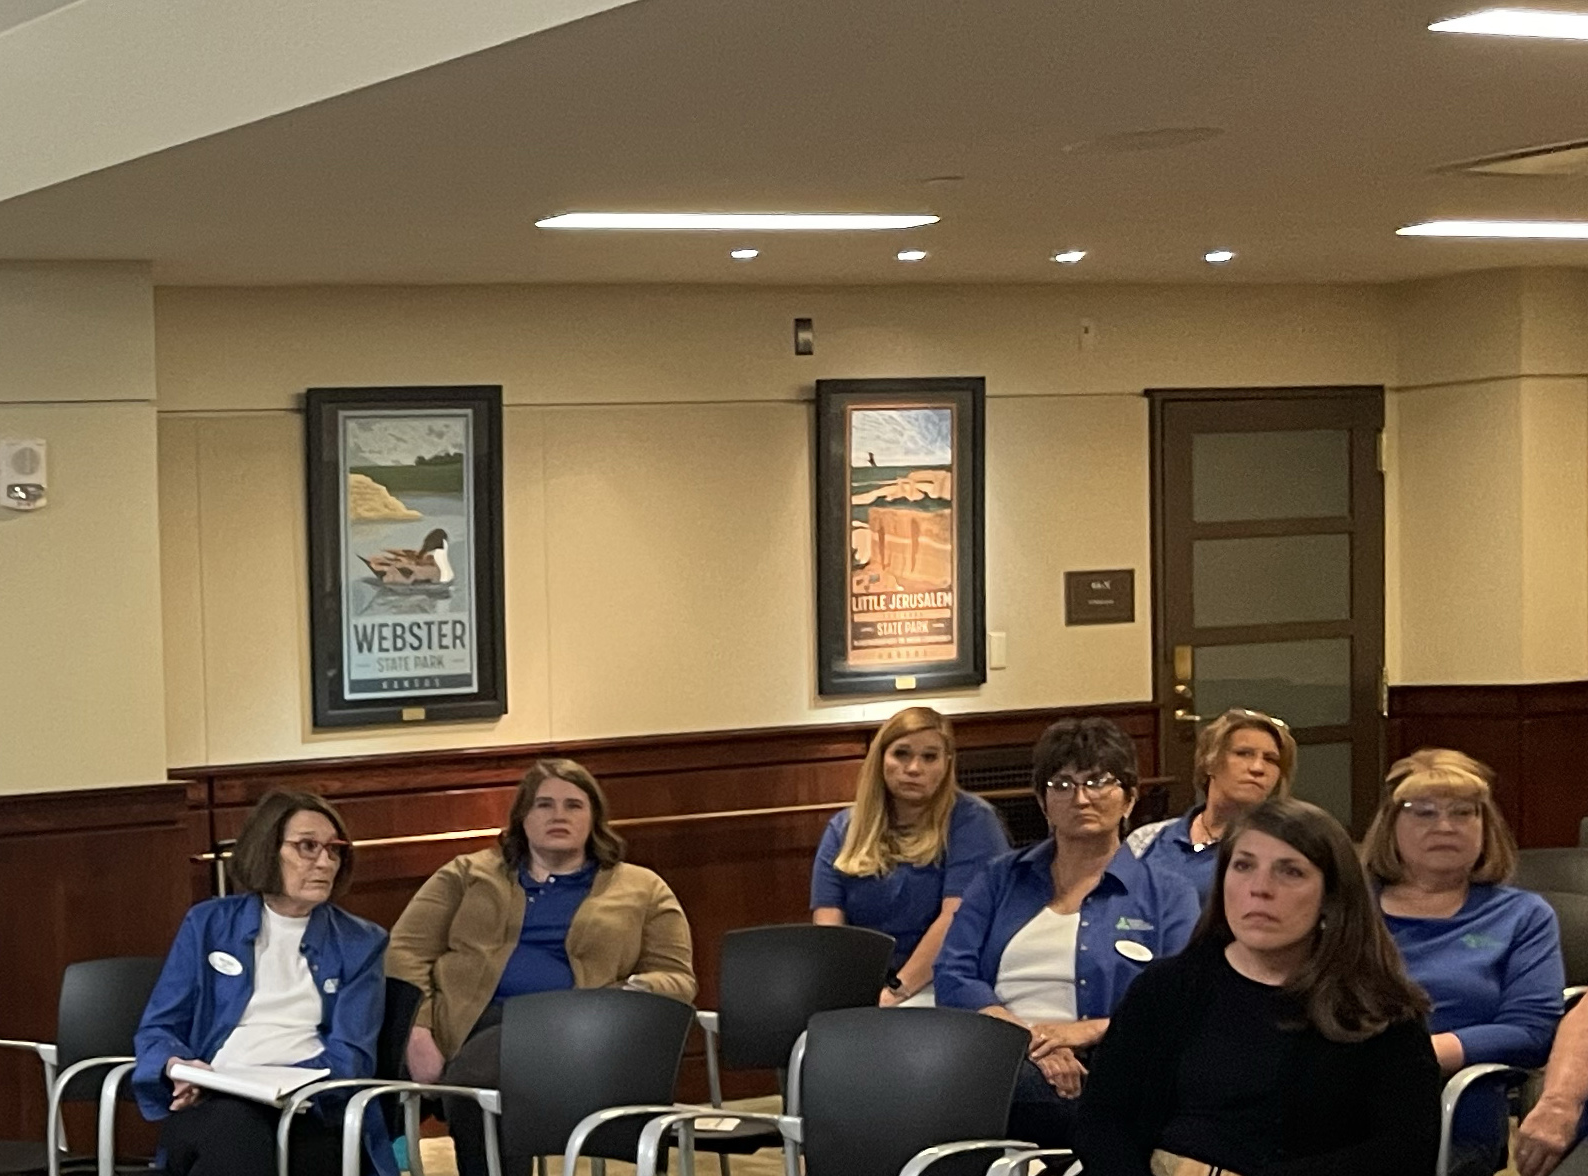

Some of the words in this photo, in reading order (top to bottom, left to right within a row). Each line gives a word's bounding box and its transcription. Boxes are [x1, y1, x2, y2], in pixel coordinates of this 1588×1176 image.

[852, 594, 887, 612] LITTLE
[888, 591, 952, 610] JERUSALEM
[353, 619, 466, 654] WEBSTER
[876, 621, 903, 636] STATE
[904, 620, 929, 633] PARK
[376, 656, 411, 673] STATE
[414, 654, 445, 670] PARK
